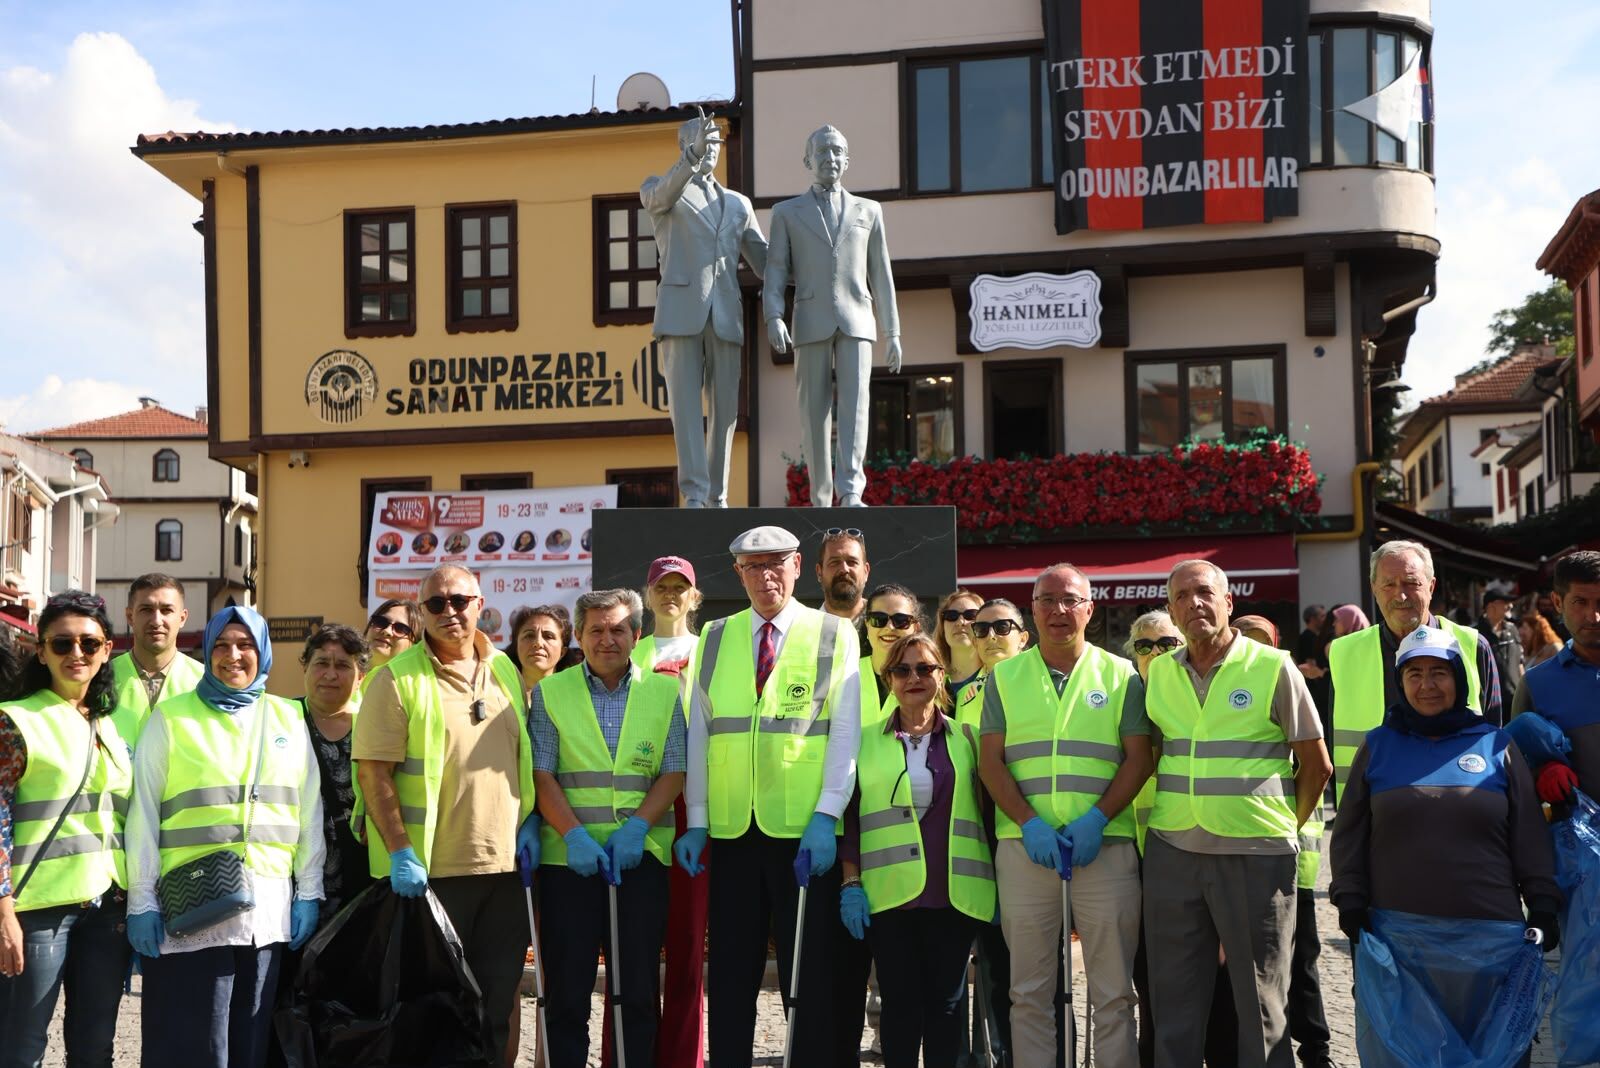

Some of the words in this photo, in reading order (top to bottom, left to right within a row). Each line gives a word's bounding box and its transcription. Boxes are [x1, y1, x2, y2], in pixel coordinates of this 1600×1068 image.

[1051, 55, 1148, 93] TERK
[1154, 37, 1296, 82] ETMEDİ
[1064, 102, 1204, 142] SEVDAN
[1211, 90, 1286, 132] BİZİ
[1060, 156, 1299, 200] ODUNBAZARLILAR
[983, 299, 1088, 321] HANIMELİ
[385, 383, 488, 416] SANAT
[497, 503, 509, 518] 19
[518, 503, 531, 517] 23
[493, 578, 505, 592] 19
[513, 578, 527, 592] 23
[1114, 585, 1168, 600] BERBE
